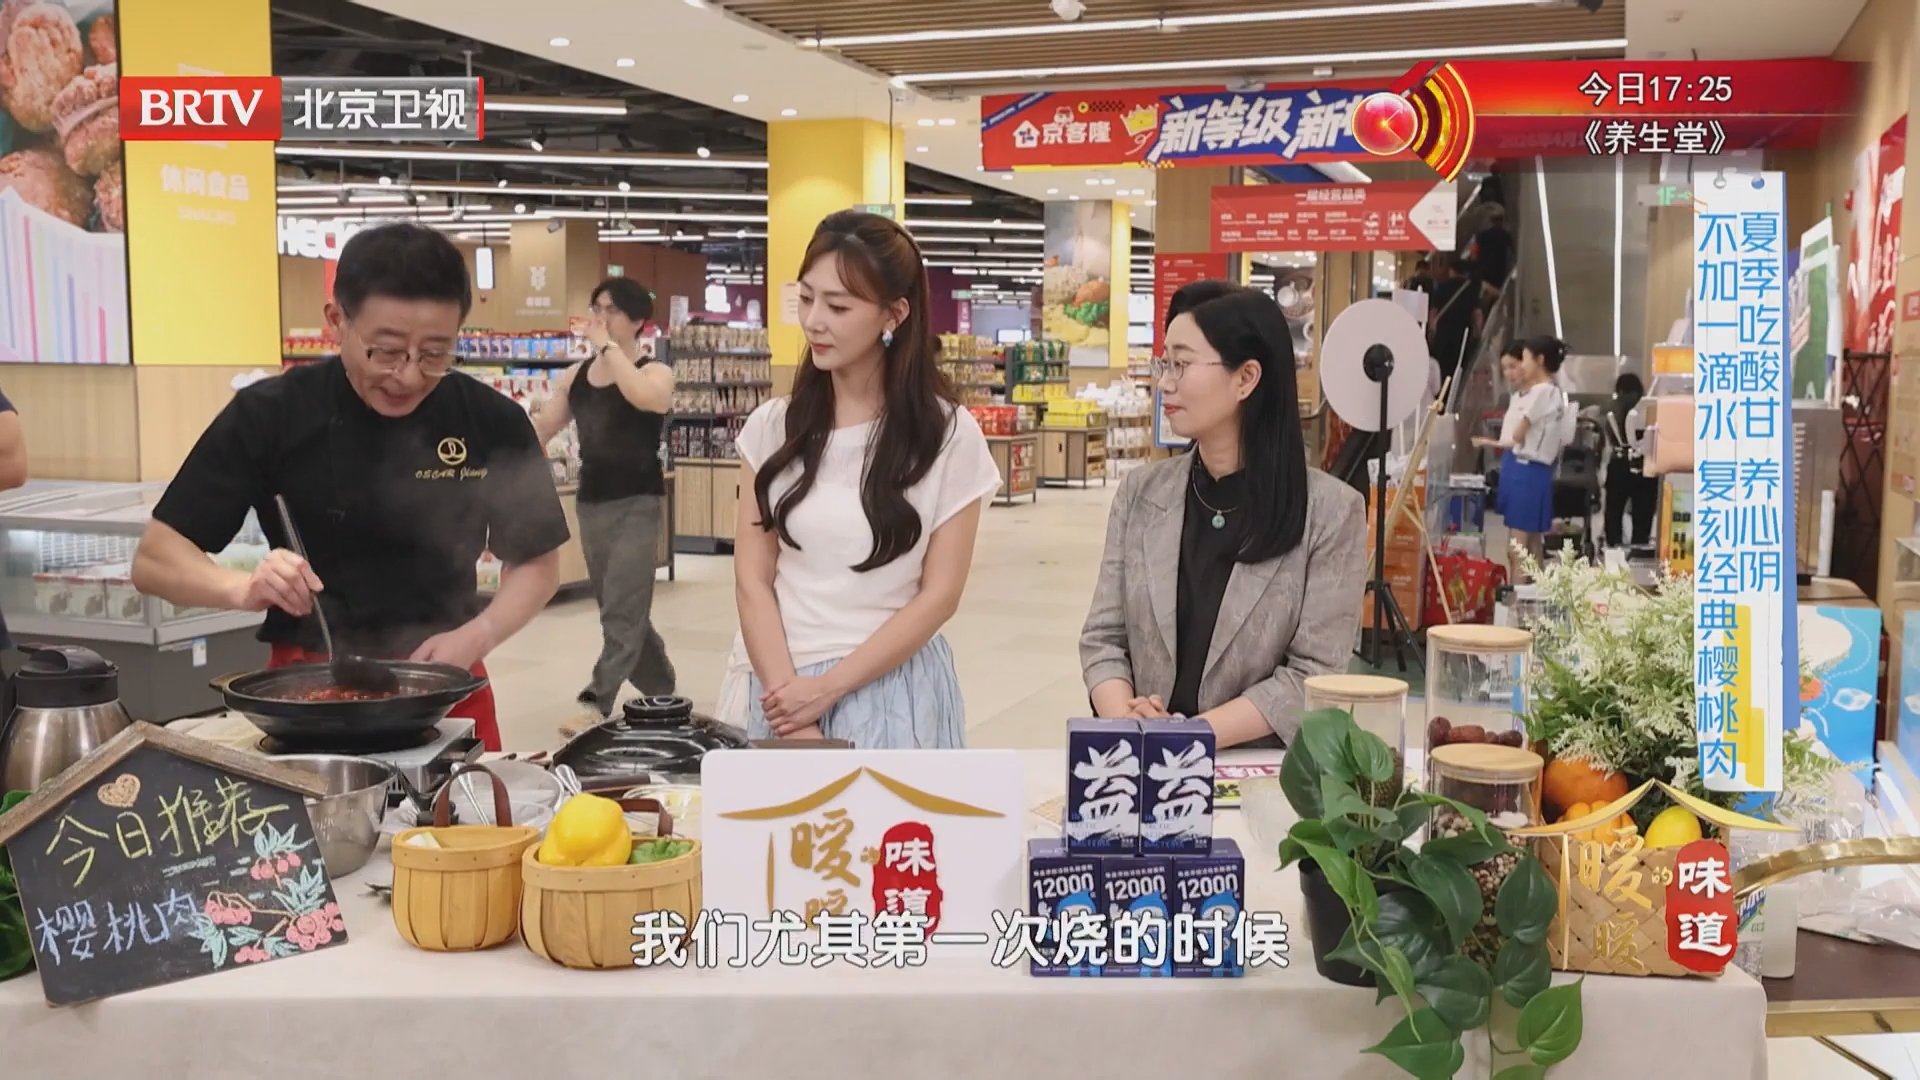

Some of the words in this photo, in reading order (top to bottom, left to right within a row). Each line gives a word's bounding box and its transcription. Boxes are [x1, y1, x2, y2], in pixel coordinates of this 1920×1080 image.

[1041, 121, 1113, 146] 京客隆
[1146, 92, 1295, 164] 新等级
[1284, 89, 1356, 160] 新
[1656, 185, 1676, 206] 1F
[1066, 738, 1141, 842] 益
[1140, 739, 1215, 842] 益
[1033, 873, 1095, 900] 12000
[1105, 874, 1167, 901] 12000
[1177, 873, 1239, 900] 12000
[1678, 857, 1733, 957] 味道
[35, 888, 199, 966] 樱桃肉
